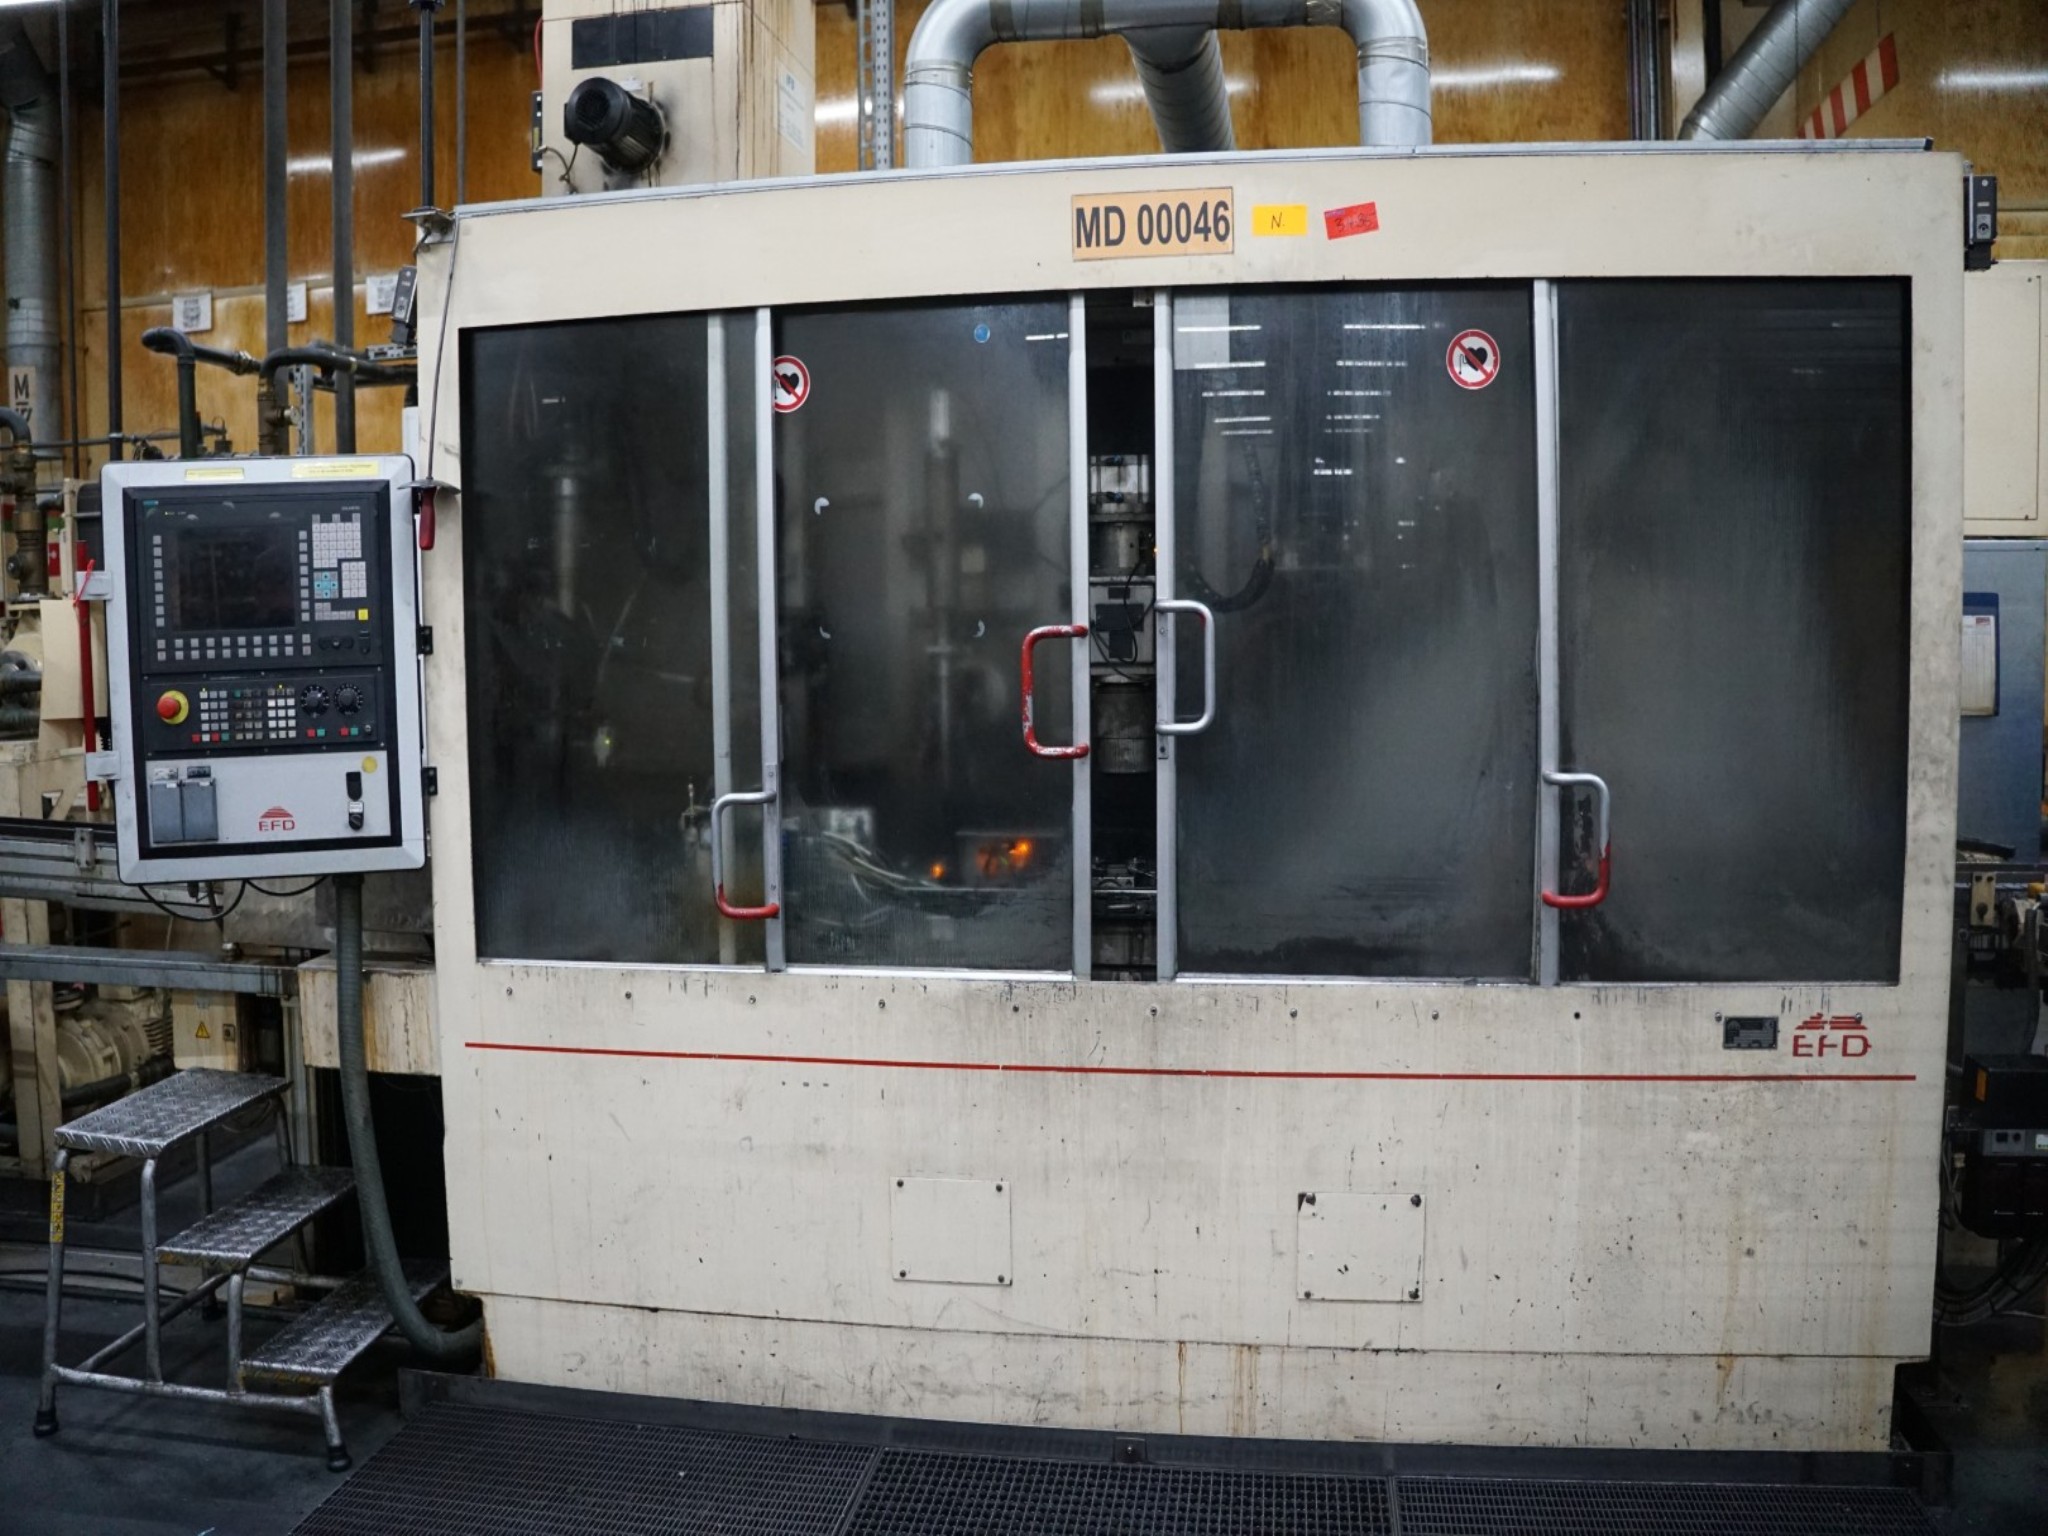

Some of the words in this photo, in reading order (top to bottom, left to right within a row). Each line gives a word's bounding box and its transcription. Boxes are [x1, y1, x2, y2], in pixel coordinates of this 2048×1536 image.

[1075, 205, 1126, 248] MD
[1137, 200, 1231, 246] 00046
[258, 819, 295, 831] EFD
[1792, 1034, 1871, 1057] EFD
